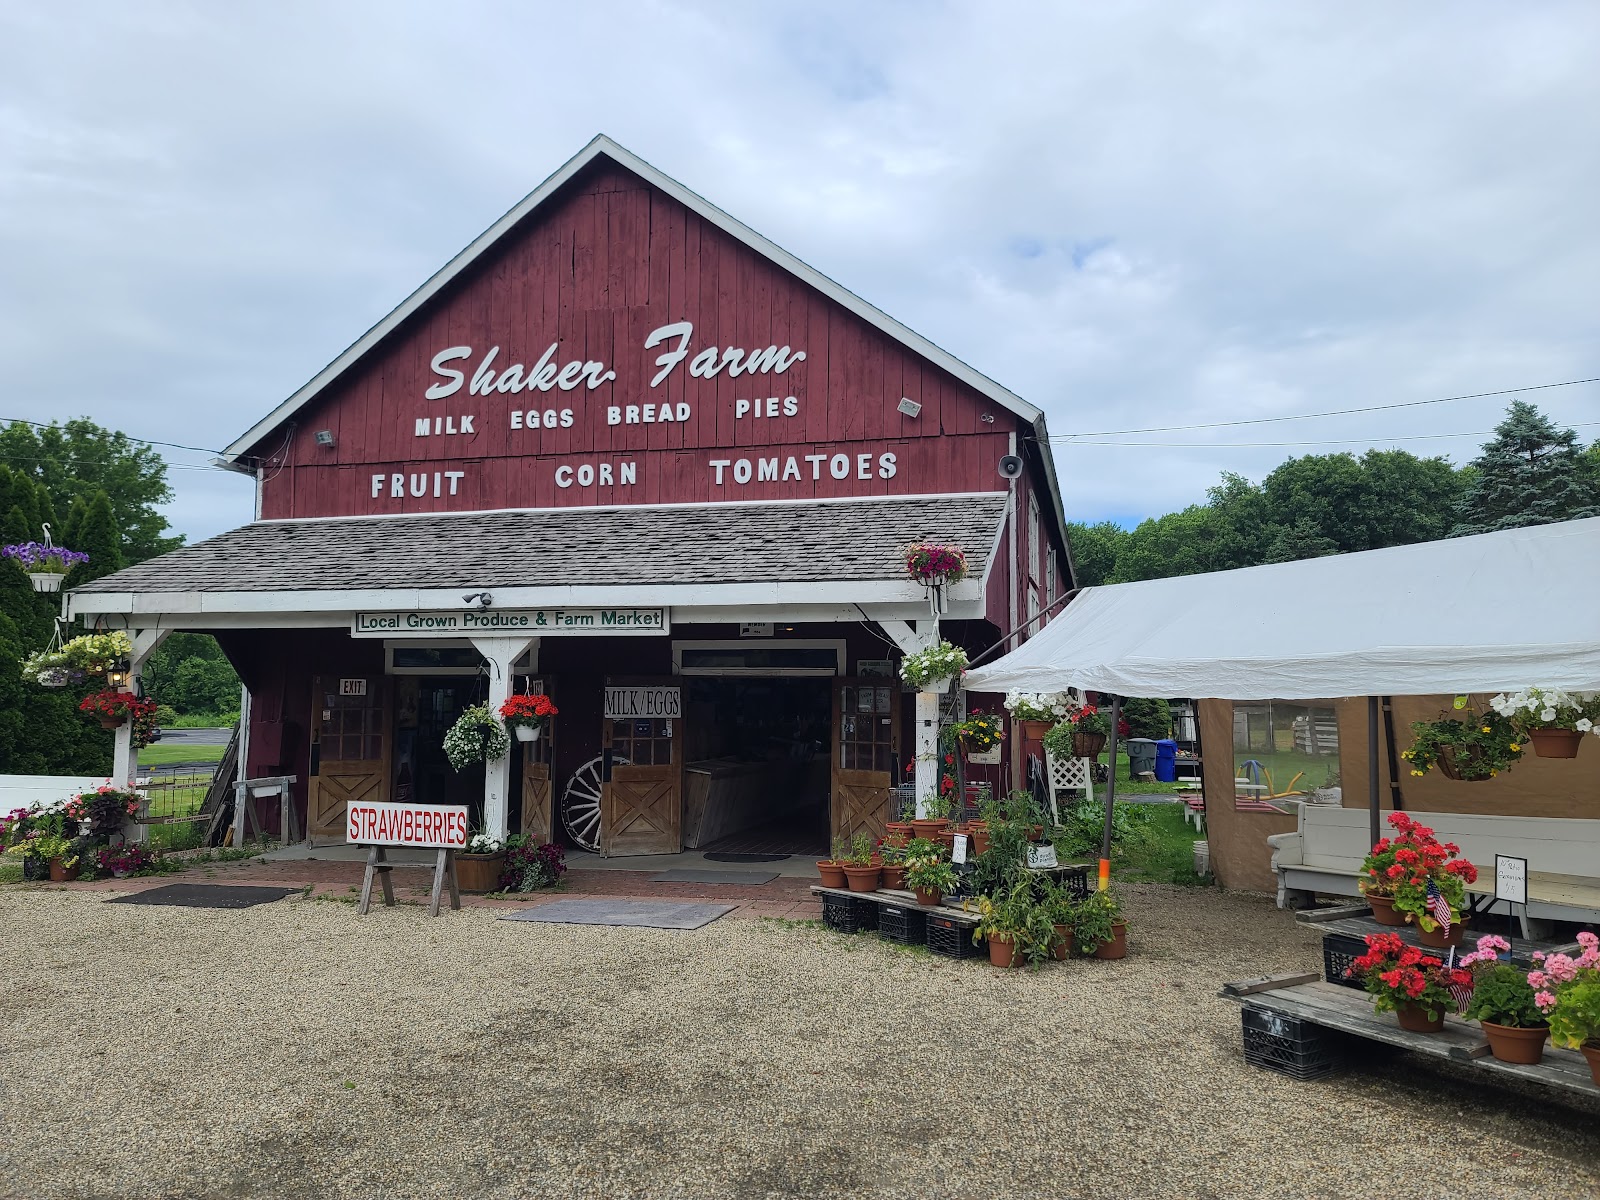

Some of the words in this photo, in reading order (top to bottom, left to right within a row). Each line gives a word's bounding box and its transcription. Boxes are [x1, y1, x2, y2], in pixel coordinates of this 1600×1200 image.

[425, 343, 616, 400] Shaker
[644, 322, 807, 388] Farm
[416, 415, 475, 437] MILK
[510, 408, 574, 430] EGGS
[607, 402, 691, 425] BREAD
[735, 396, 798, 419] PIES
[371, 471, 465, 498] FRUIT
[554, 461, 637, 488] CORN
[709, 452, 897, 485] TOMATOES
[361, 614, 400, 629] Local
[406, 613, 457, 628] Grown
[463, 612, 528, 627] Produce
[535, 611, 547, 626] &
[555, 611, 594, 625] Farm
[601, 610, 660, 625] Market
[343, 680, 362, 694] EXIT
[605, 690, 679, 715] MILK/EGGS
[350, 807, 467, 845] STRAWBERRIES
